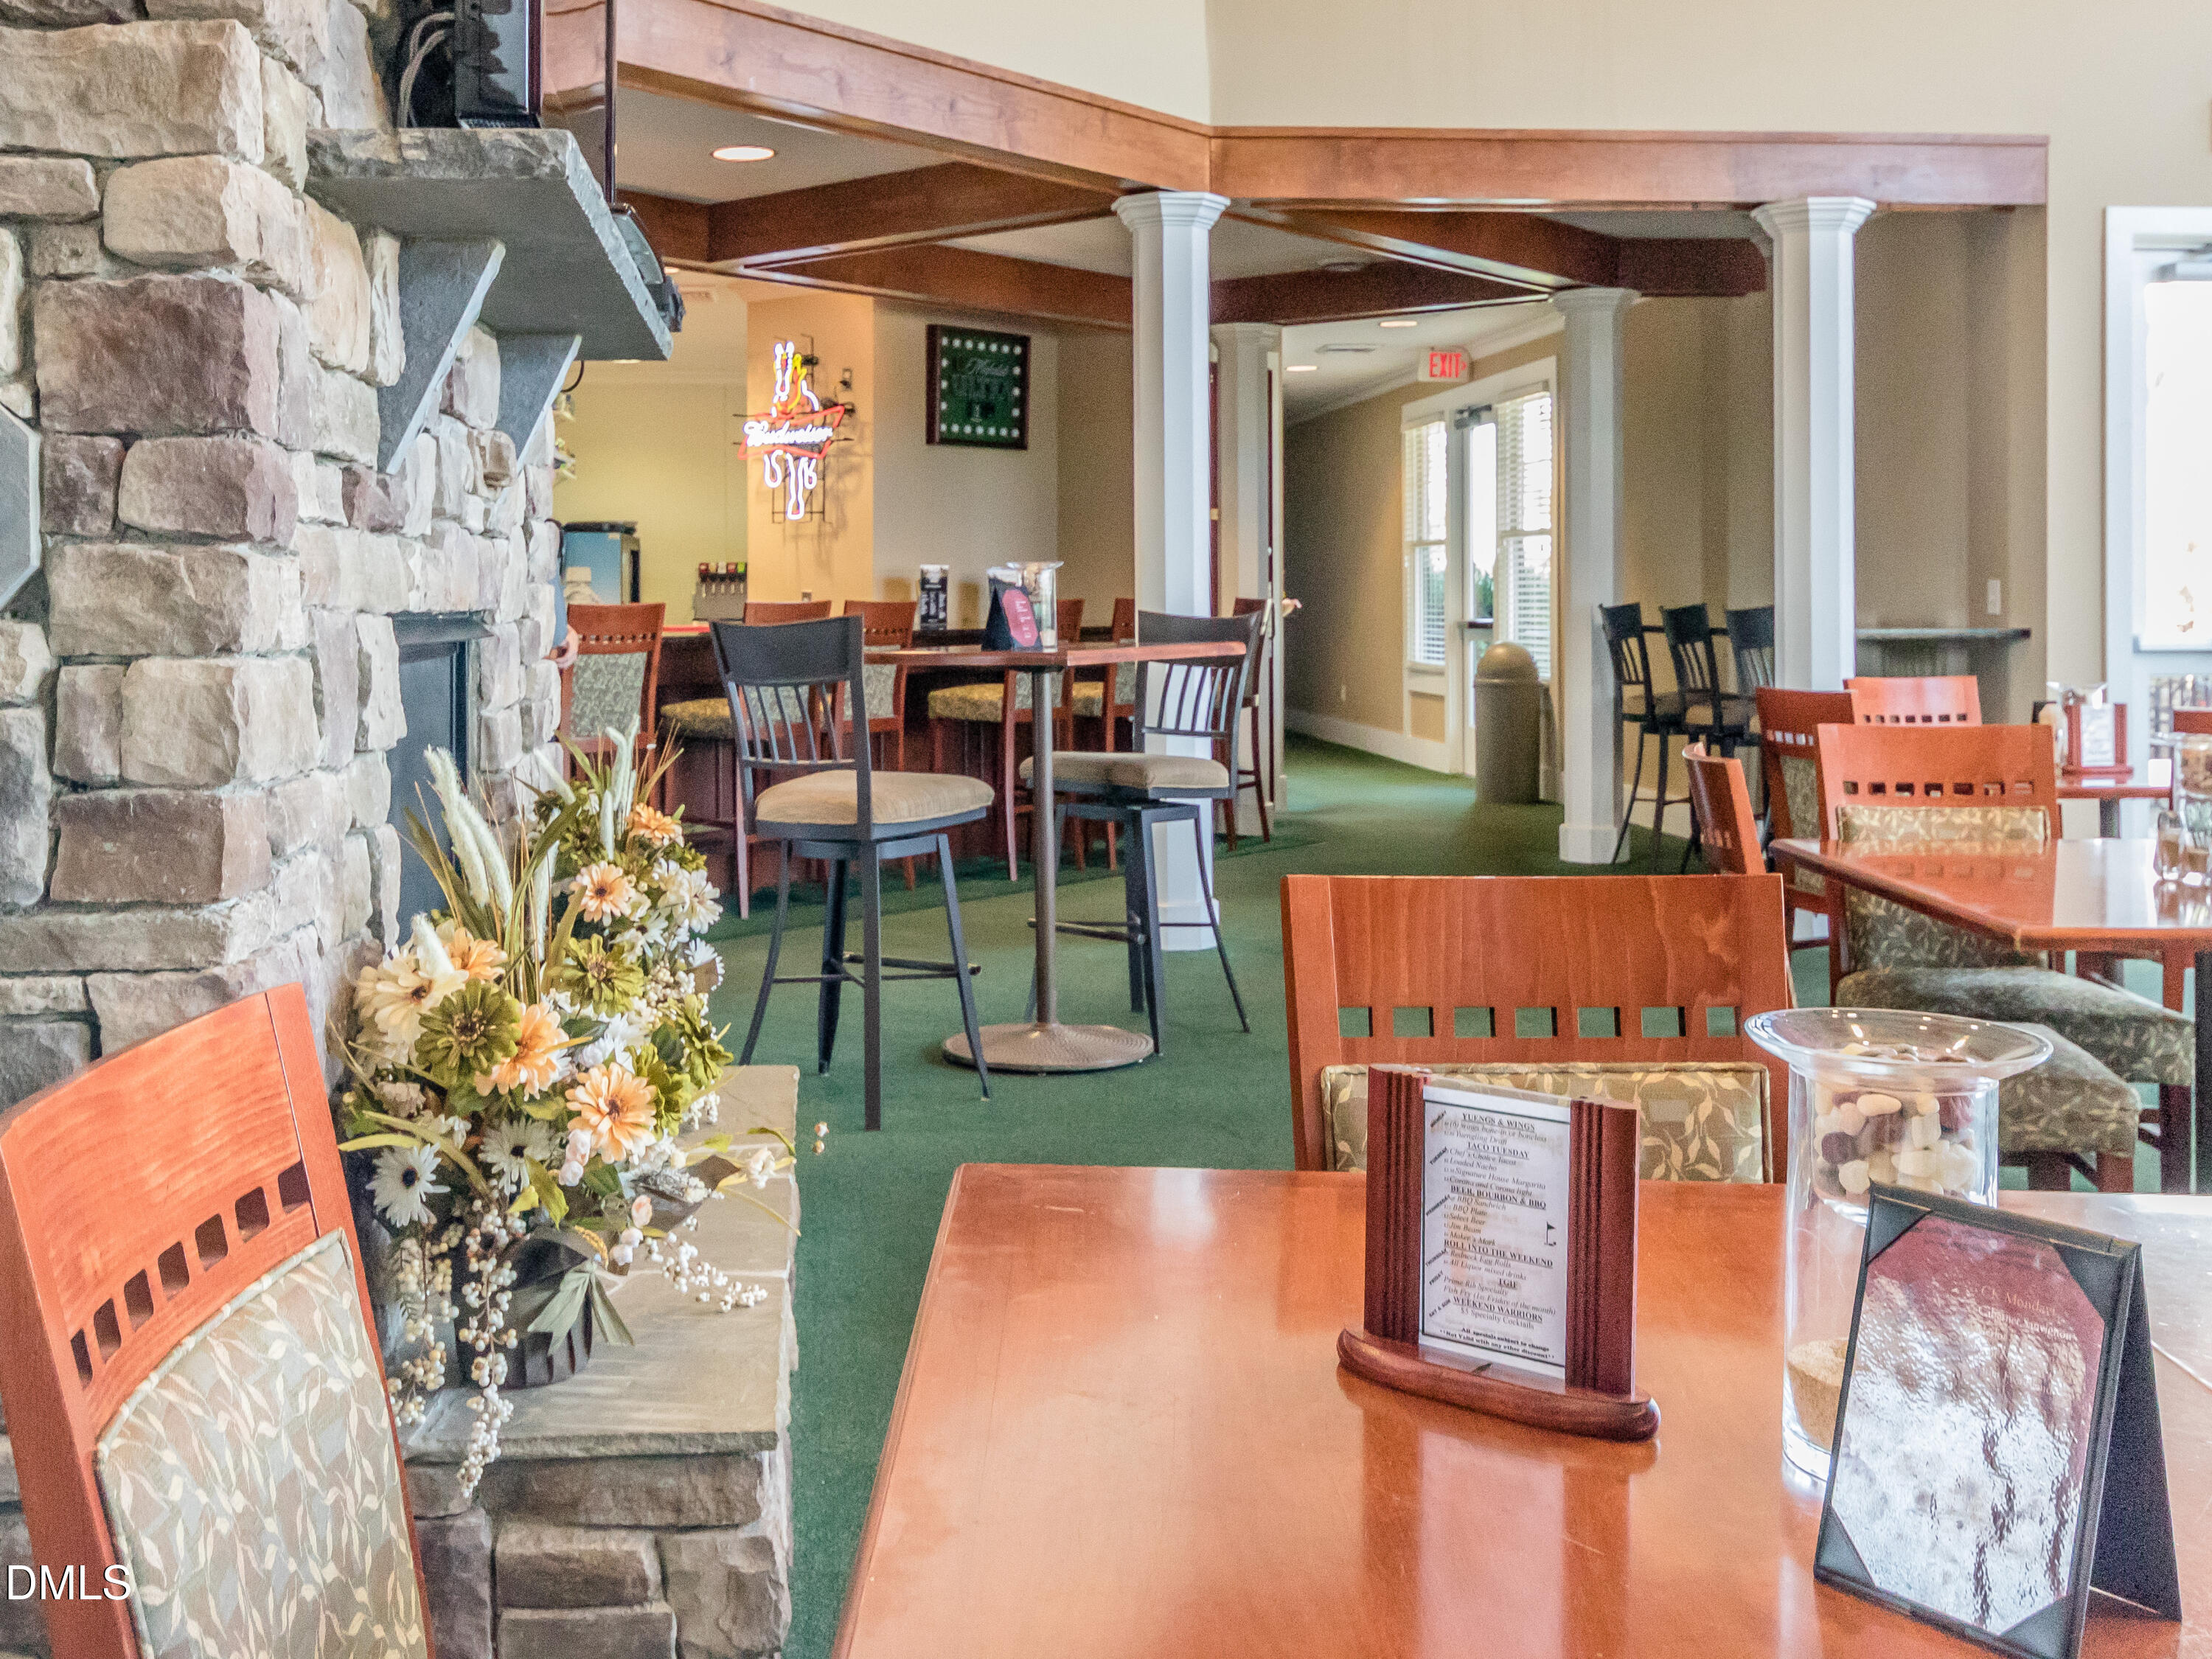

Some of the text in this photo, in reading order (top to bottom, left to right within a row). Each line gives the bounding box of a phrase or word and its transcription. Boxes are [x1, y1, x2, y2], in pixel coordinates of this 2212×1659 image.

[1429, 352, 1461, 378] EXIT
[742, 420, 834, 448] Budweiser
[1463, 1113, 1496, 1125] YUENGS
[1498, 1119, 1504, 1127] &
[1507, 1119, 1535, 1131] WINGS
[1518, 1130, 1547, 1142] boneless
[1467, 1141, 1529, 1159] TACO TUESDAY
[1472, 1152, 1496, 1162] Choice
[1476, 1160, 1498, 1172] Nacho
[1450, 1176, 1475, 1186] Corona
[1475, 1180, 1489, 1189] and
[1490, 1181, 1516, 1194] Corona
[1455, 1168, 1487, 1180] Signature
[1489, 1172, 1509, 1183] House
[1512, 1178, 1546, 1190] Margarita
[1457, 1195, 1473, 1206] BBQ
[1475, 1197, 1506, 1211] Sandwich
[1476, 1189, 1517, 1203] BOURBON
[1520, 1197, 1527, 1206] &
[1528, 1198, 1547, 1209] BBQ
[1450, 1213, 1469, 1223] Select
[1471, 1215, 1486, 1225] Beer
[1453, 1204, 1469, 1214] BBQ
[1470, 1206, 1488, 1216] Plate
[1450, 1221, 1461, 1230] Jim
[1464, 1224, 1481, 1234] Beam
[1478, 1236, 1496, 1247] Mark
[1444, 1239, 1554, 1267] ROLL INTO THE WEEKEND
[1450, 1250, 1477, 1261] Redneck
[1495, 1256, 1512, 1268] Rolls
[1461, 1259, 1482, 1272] Liquor
[1484, 1265, 1504, 1276] mixed
[1506, 1268, 1527, 1281] drinks
[1444, 1276, 1509, 1296] Prime Rib Specialty
[1443, 1284, 1458, 1294] Fish
[1461, 1287, 1472, 1297] Fry
[1487, 1295, 1510, 1307] Friday
[1512, 1298, 1519, 1309] of
[1520, 1301, 1530, 1310] the
[1531, 1304, 1557, 1316] month)
[1453, 1296, 1543, 1322] WEEKEND WARRIORS
[1470, 1309, 1500, 1323] Specialty
[1503, 1315, 1534, 1330] Cocktails
[1458, 1333, 1475, 1342] Valid
[1475, 1337, 1490, 1346] with
[1503, 1344, 1520, 1352] other
[1473, 1331, 1497, 1340] specials
[1498, 1336, 1520, 1346] subject
[1528, 1343, 1550, 1353] change
